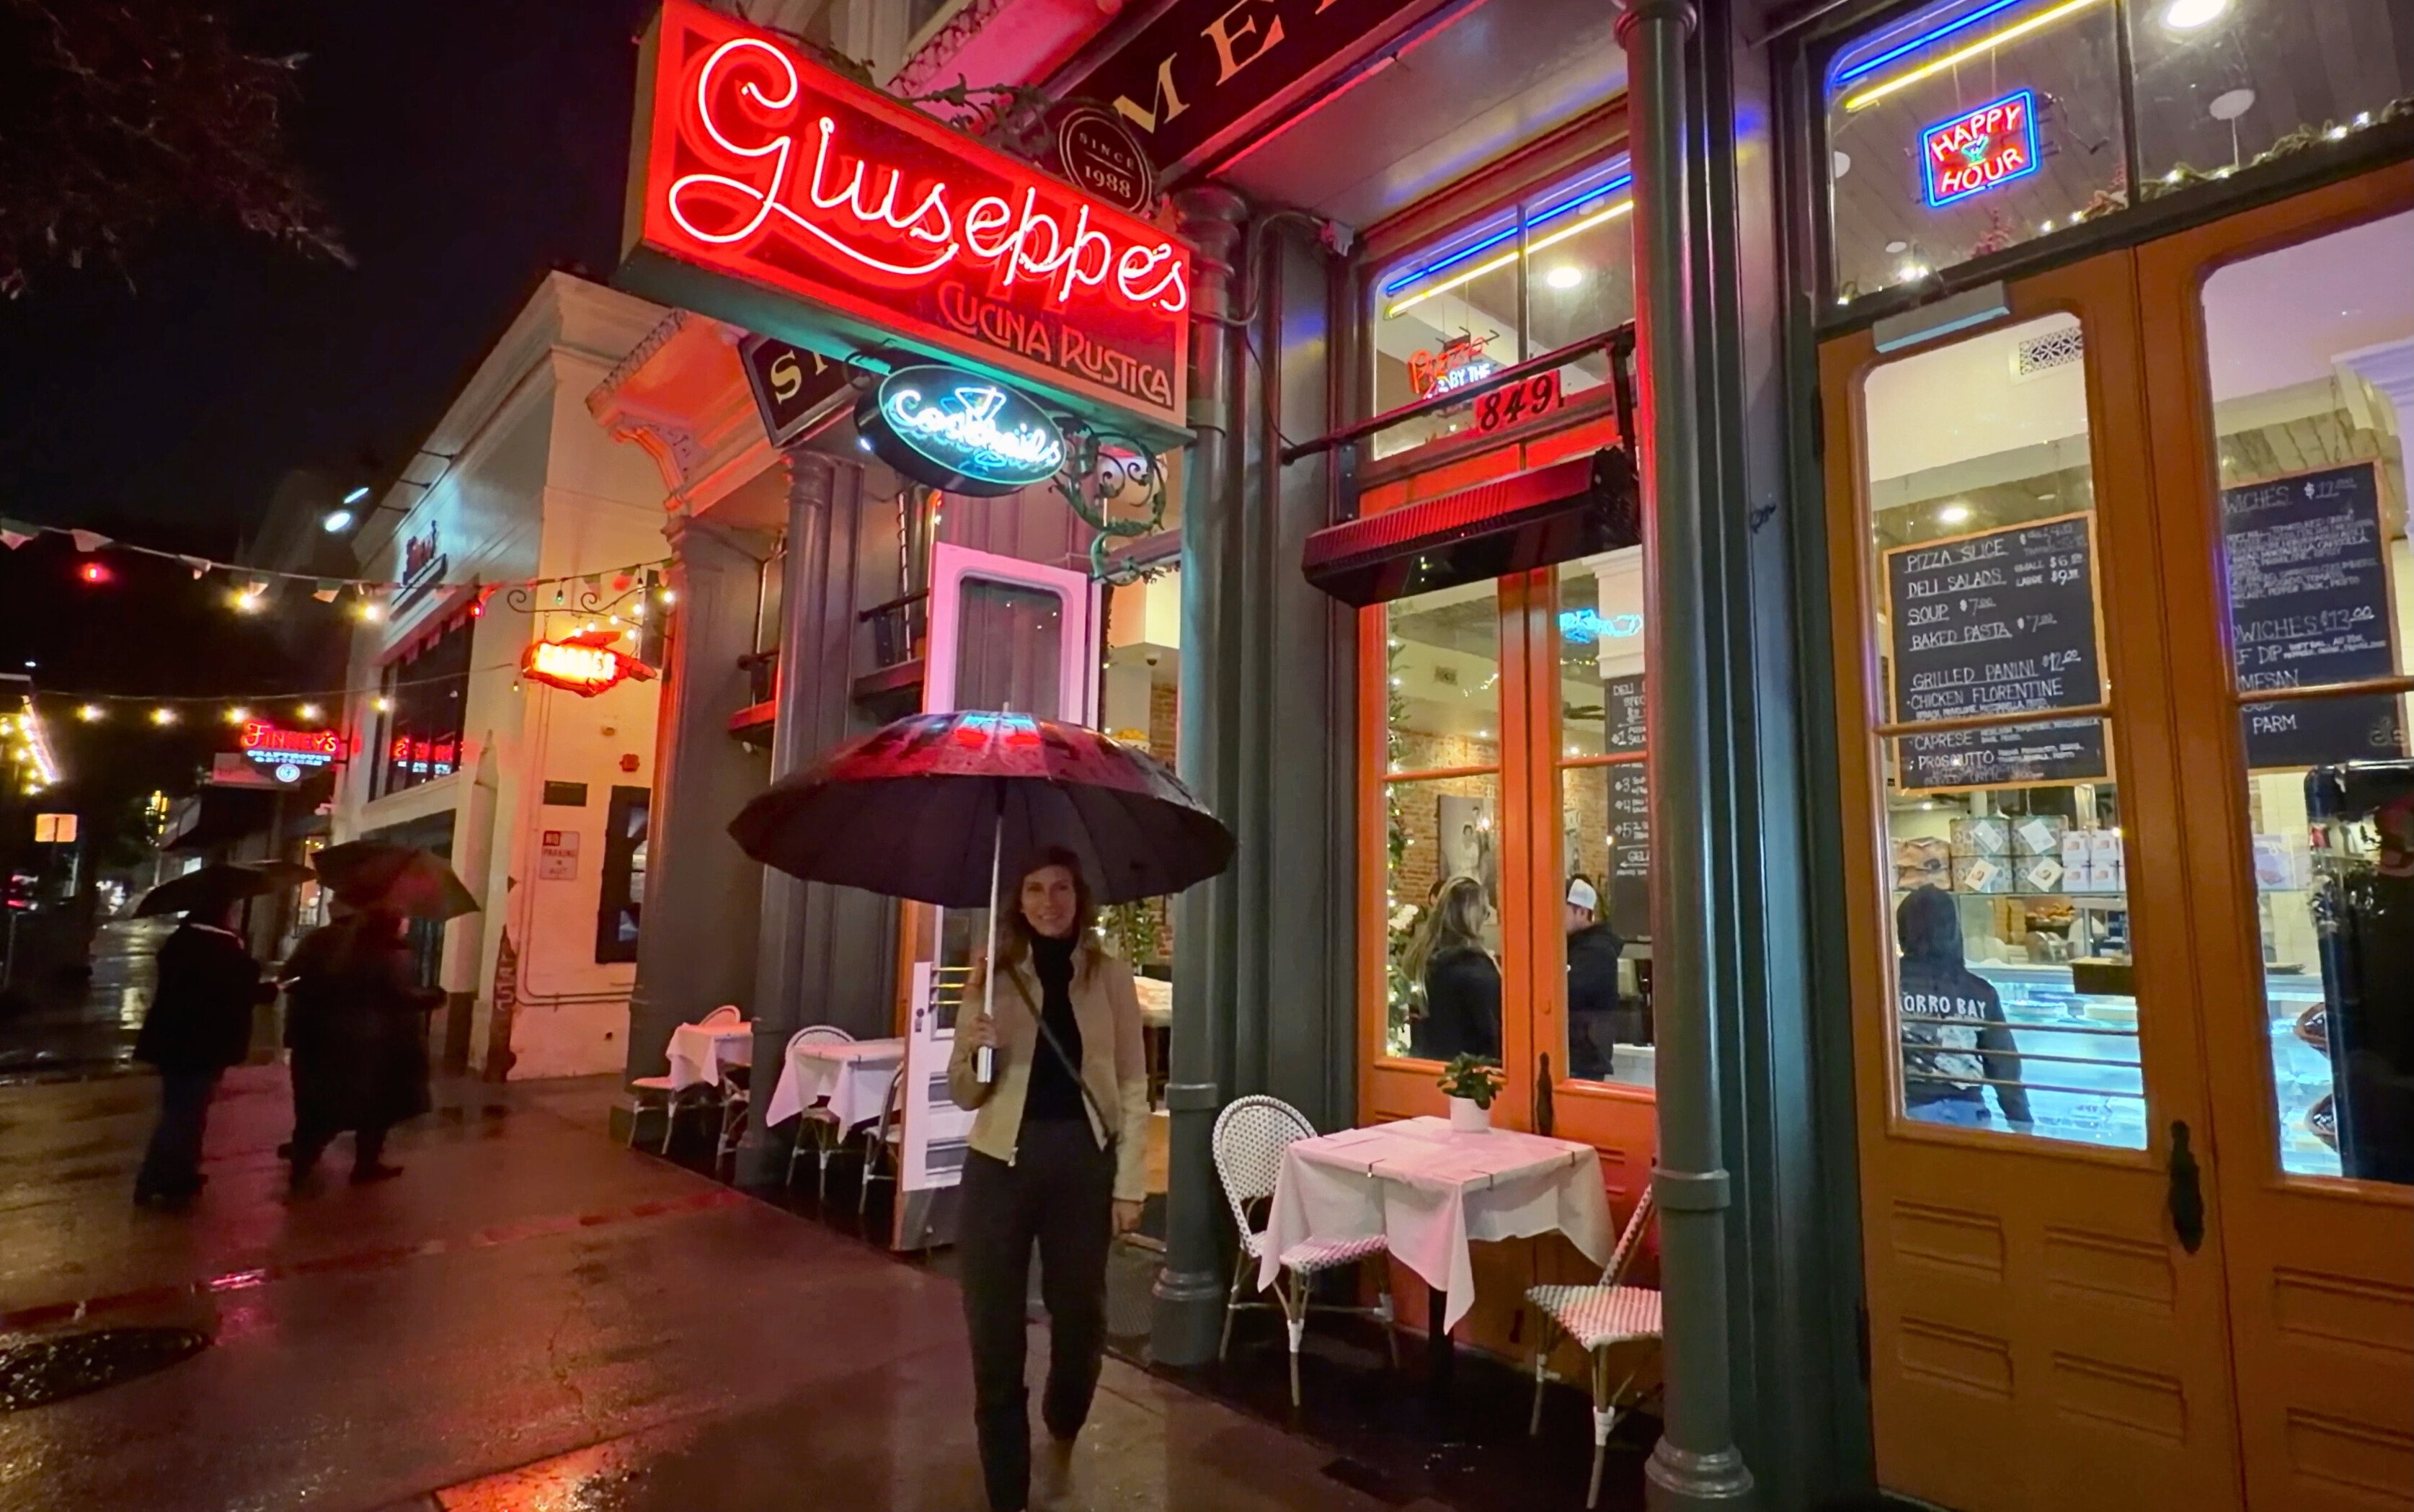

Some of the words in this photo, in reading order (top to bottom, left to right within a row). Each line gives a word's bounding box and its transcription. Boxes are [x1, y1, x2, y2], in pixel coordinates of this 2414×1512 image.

[1113, 0, 1342, 134] ME
[1931, 106, 2021, 161] HAPPY
[1079, 132, 1135, 171] SINCE
[669, 37, 1187, 313] Giuseppe's
[1085, 165, 1131, 199] 1988
[1940, 147, 2024, 192] HOUR
[938, 280, 1051, 362] CUCINA
[1060, 324, 1172, 408] RUSTICA
[1478, 374, 1552, 431] 849
[1907, 549, 1952, 573] PIZZA
[1961, 538, 2005, 561] SLICE
[1908, 578, 1938, 598] DELI
[1947, 567, 2002, 591] SALADS
[1908, 604, 1948, 626] SOUP
[1912, 630, 1958, 650] BAKED
[1964, 622, 2012, 644] PASTA
[1912, 667, 1975, 690] GRILLED
[1985, 659, 2038, 681] PANINI
[1911, 690, 1963, 711] CHICKEN
[1972, 677, 2064, 705] FLORENTINE
[1914, 731, 1975, 751] CAPRESE
[2252, 714, 2298, 735] PARM
[1899, 993, 1951, 1014] ORRO
[1956, 997, 1986, 1019] BAY
